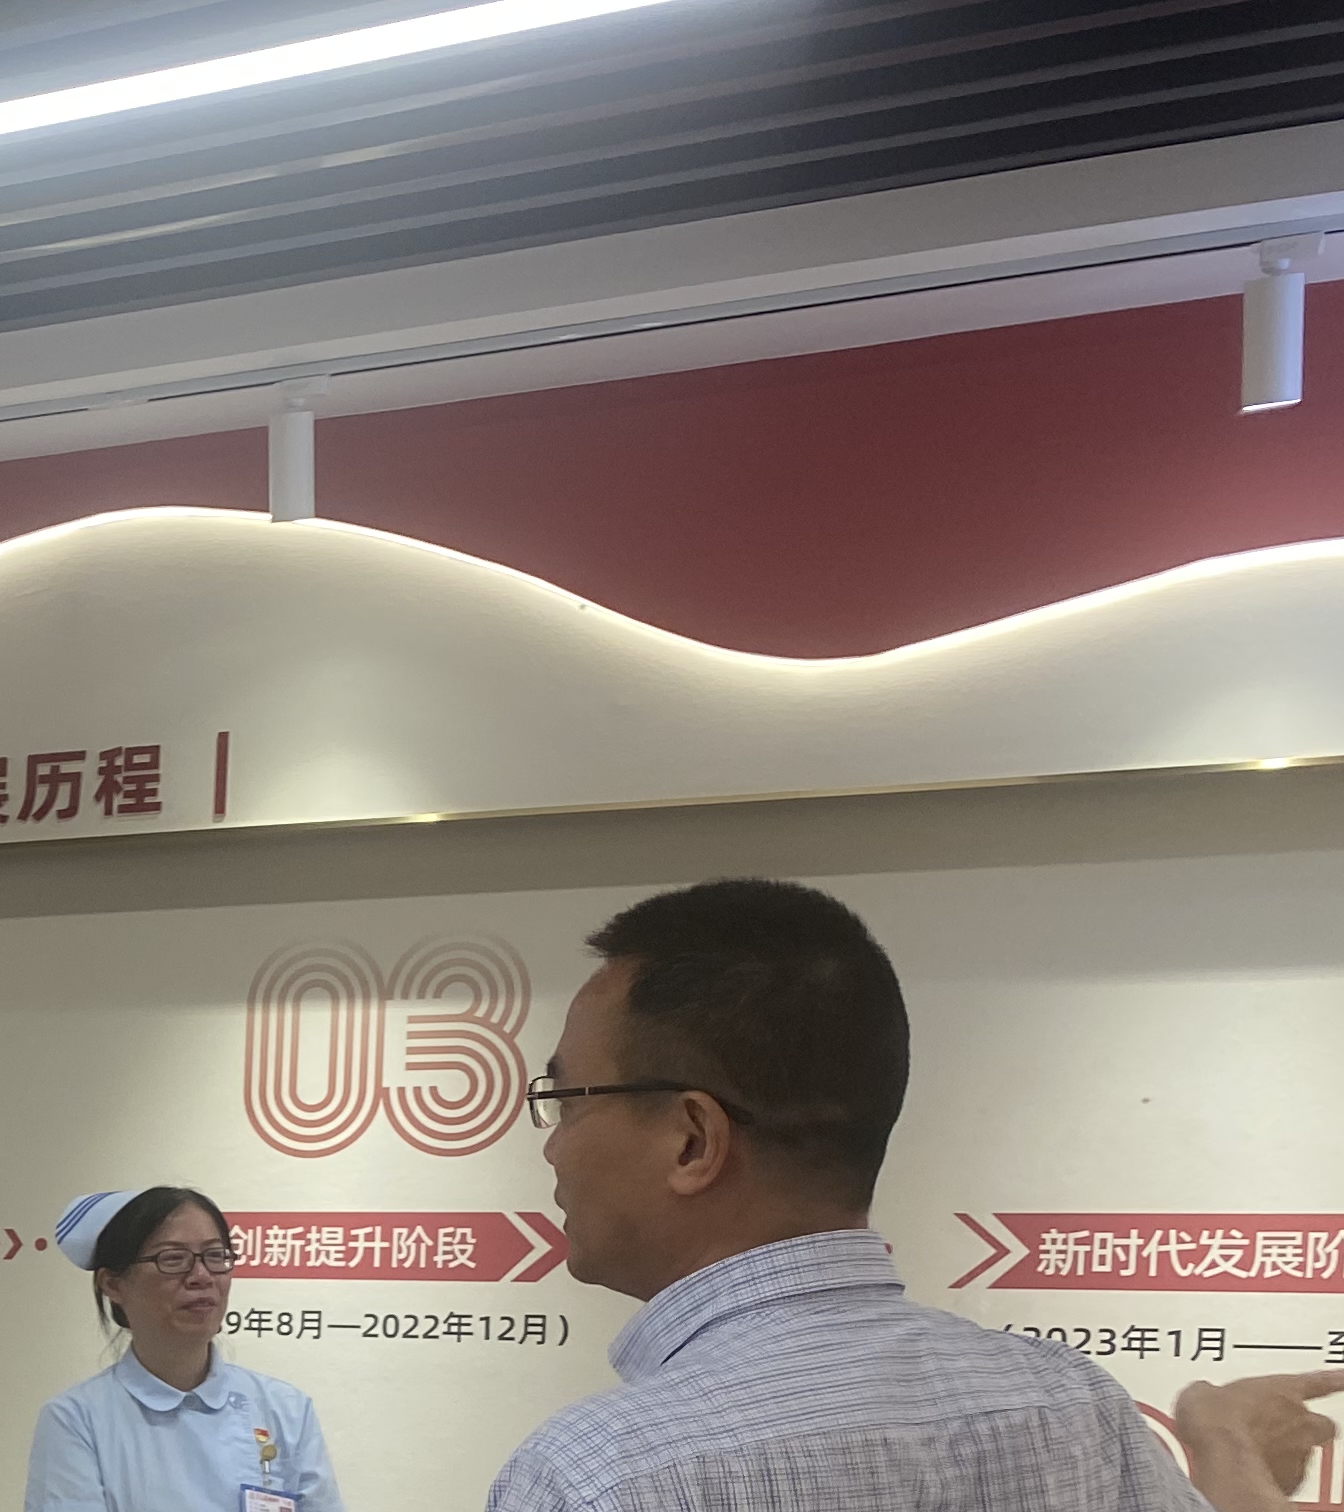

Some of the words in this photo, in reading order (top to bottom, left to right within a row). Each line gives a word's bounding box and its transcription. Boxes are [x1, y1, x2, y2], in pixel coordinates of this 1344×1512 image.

[243, 934, 531, 1158] 03
[228, 1225, 477, 1269] 创新提升阶段
[1037, 1229, 1344, 1279] 新时代发展阶
[218, 1308, 569, 1346] 9年8月—2022年12月）
